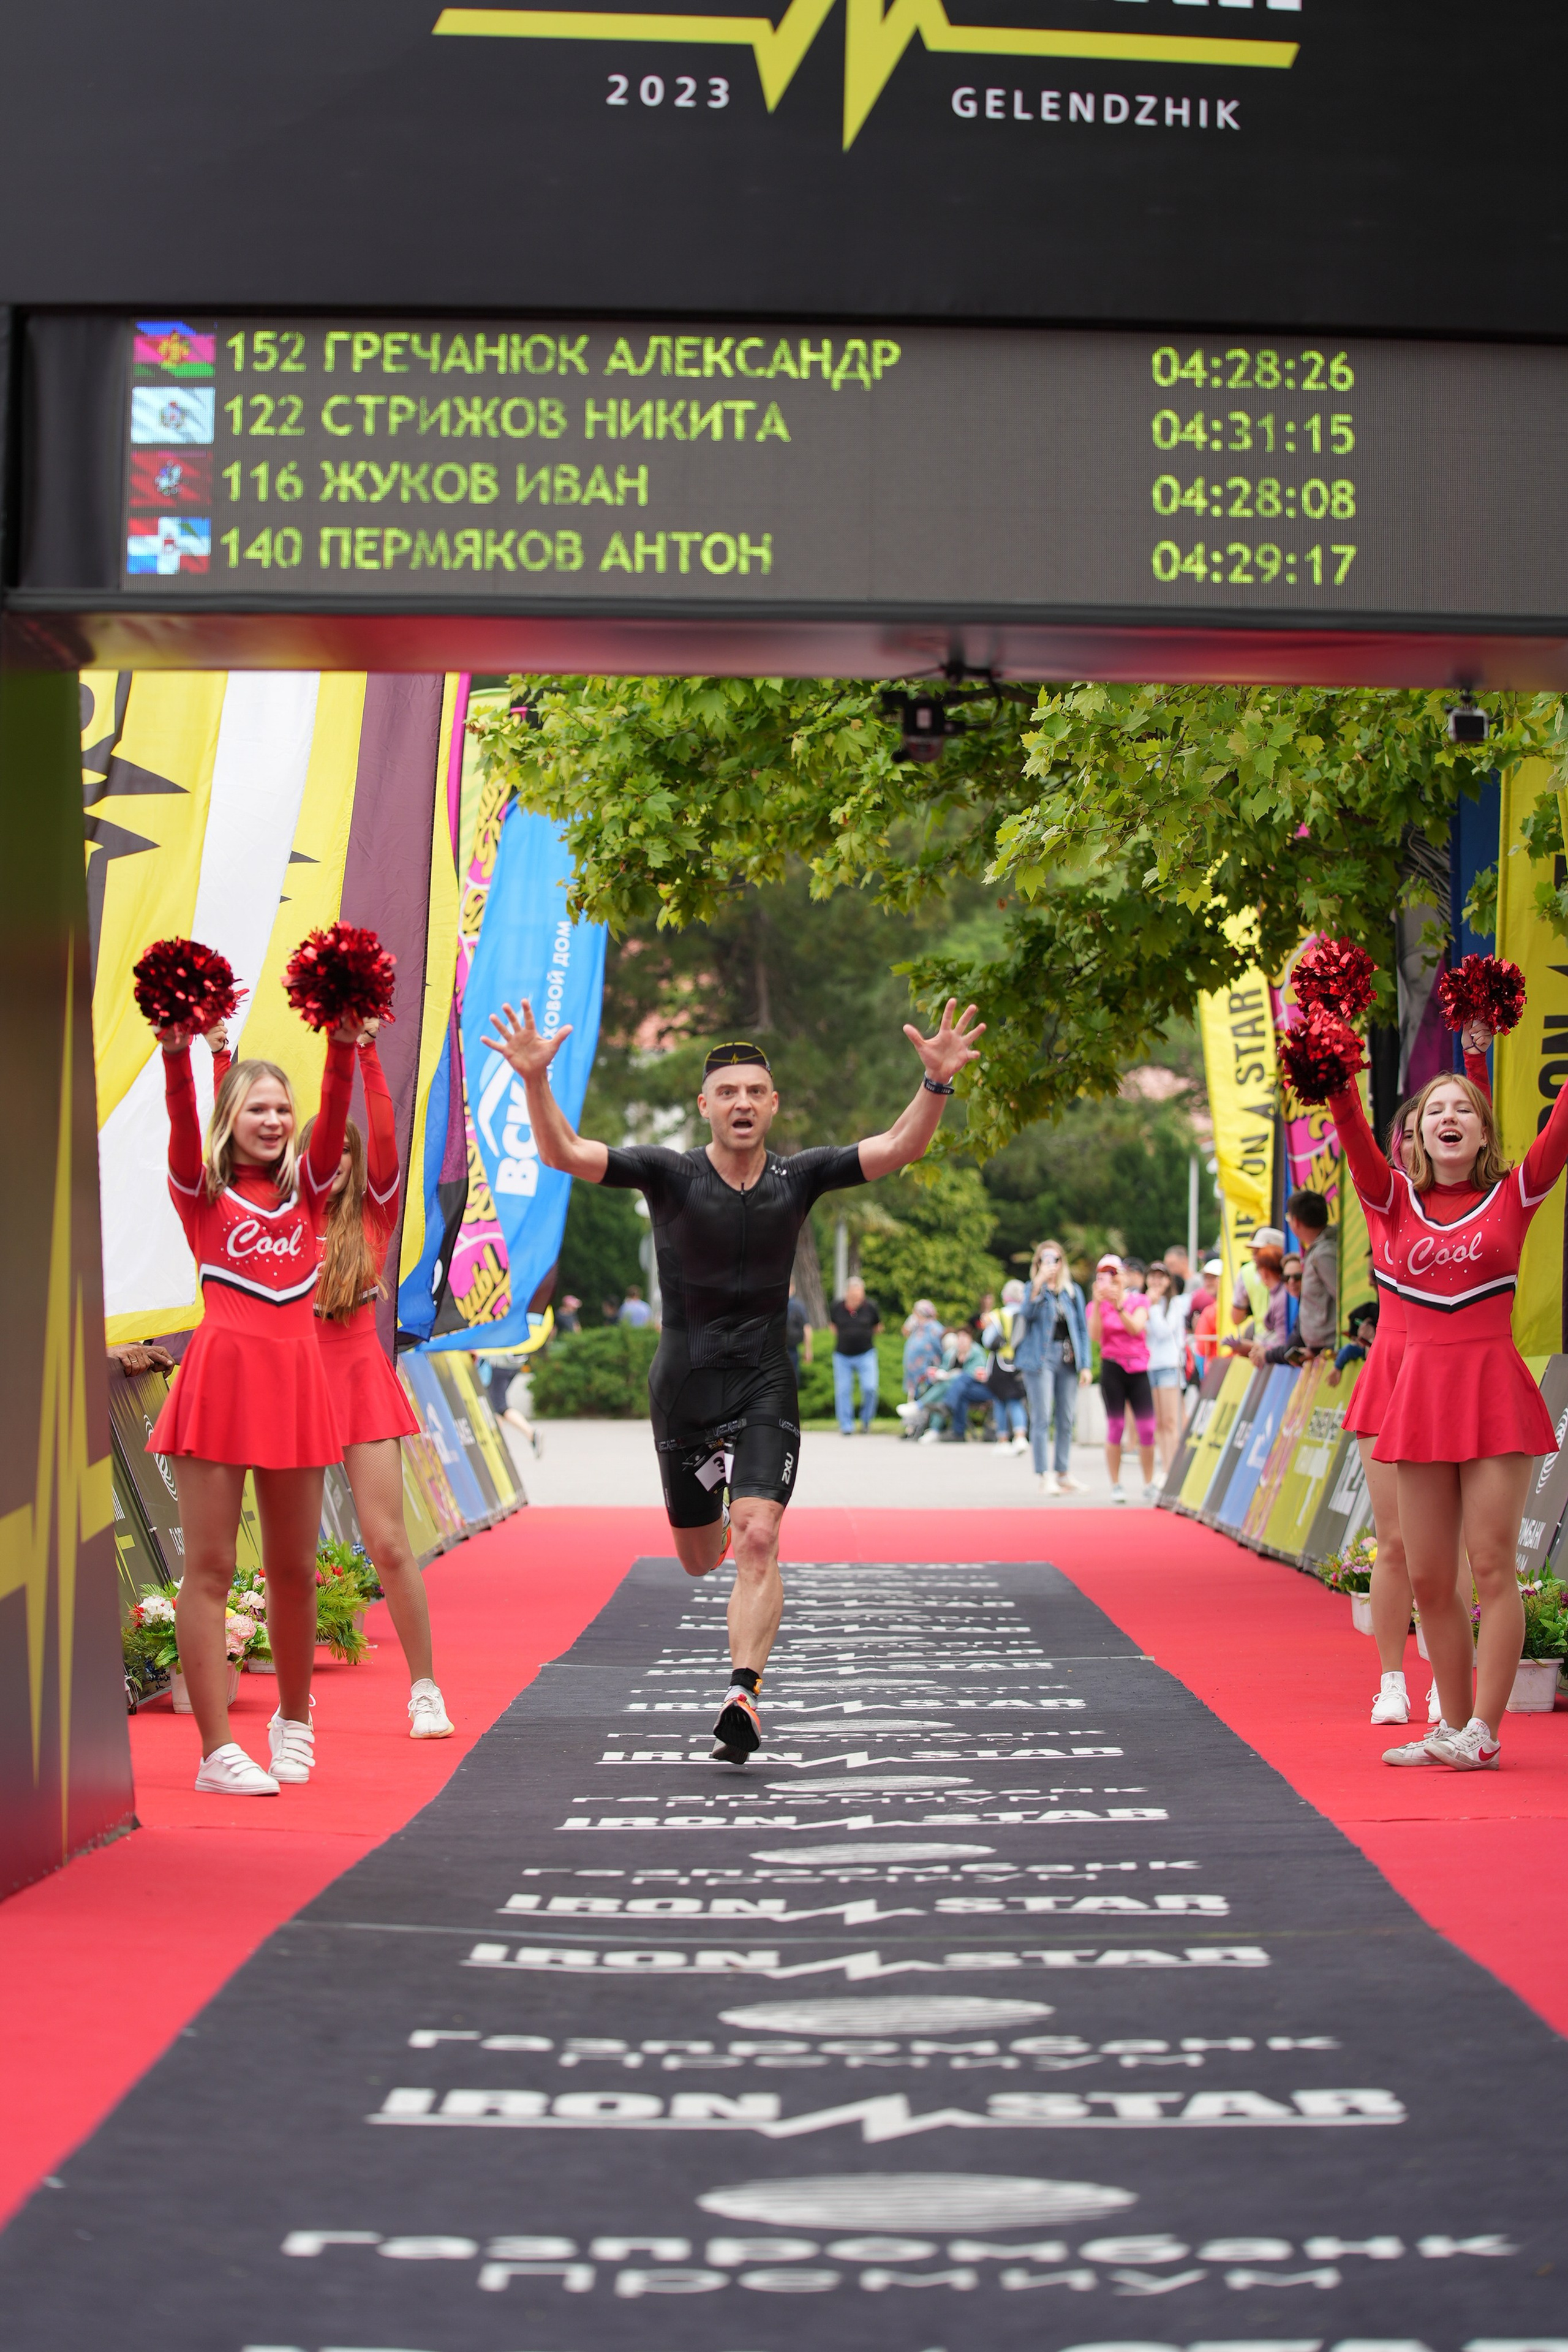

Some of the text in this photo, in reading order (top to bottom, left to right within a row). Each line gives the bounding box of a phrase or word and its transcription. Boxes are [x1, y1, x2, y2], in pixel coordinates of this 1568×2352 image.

[606, 74, 729, 108] 2023
[951, 87, 1240, 130] GELENDZHIK
[225, 330, 1355, 392] 152 ГРЕЧАНЮК АЛЕКСАНДР 04:28:26
[224, 393, 1356, 455] 122 СТРИЖОВ НИКИТА 04:31:15
[221, 459, 1357, 520] 116 ЖУКОВ ИВАН 04:28:08
[219, 526, 1358, 586] 140 ПЕРМЯКОВ АНТОН 04:29:17
[552, 920, 571, 968] ДОМ
[1228, 987, 1266, 1087] STAR
[227, 1219, 303, 1258] Cool
[1407, 1231, 1483, 1276] Cool
[782, 1452, 795, 1485] 2XU
[900, 1698, 1087, 1708] STAR
[910, 1746, 1123, 1759] STAR
[562, 1807, 1169, 1827] IRON STAR
[504, 1893, 1230, 1914] IRON STAR
[470, 1942, 1271, 1969] IRON STAR
[381, 2087, 1404, 2120] IRON STAR
[281, 2230, 1521, 2267] Газпромбанк
[477, 2263, 1343, 2299] Премиум
